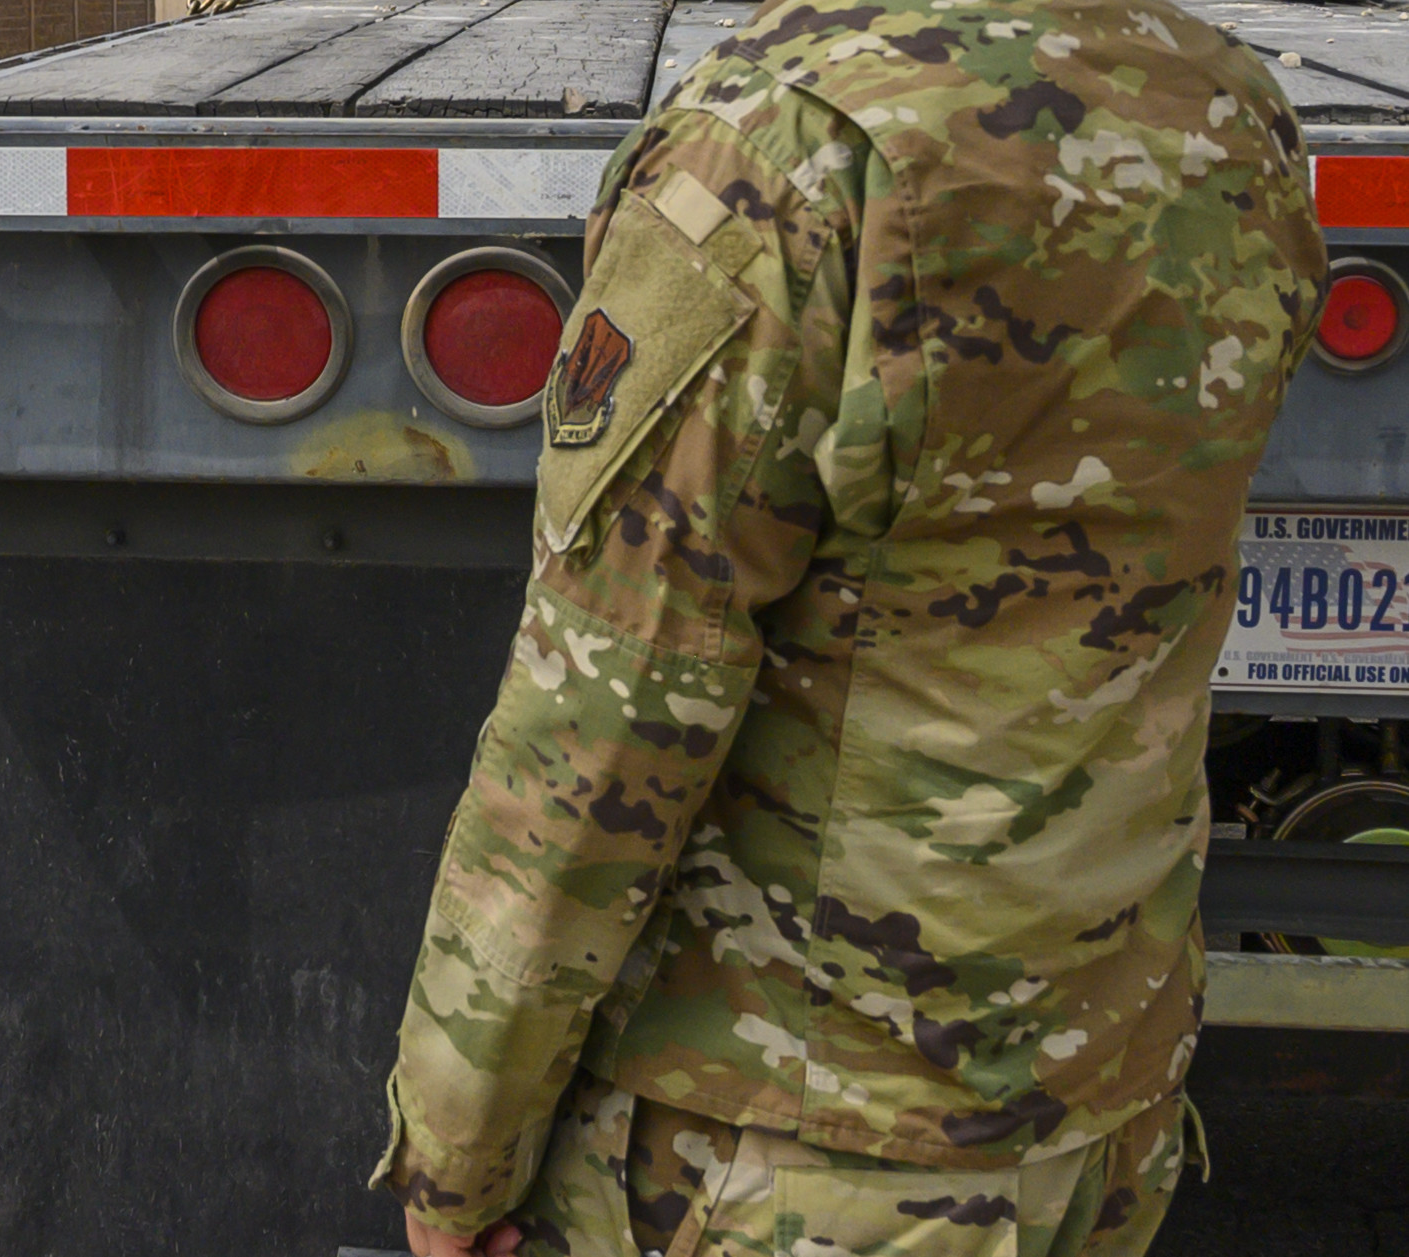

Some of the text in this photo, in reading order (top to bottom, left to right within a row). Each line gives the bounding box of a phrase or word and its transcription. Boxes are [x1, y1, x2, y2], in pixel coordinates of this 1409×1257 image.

[1254, 516, 1292, 539] U.S.
[1247, 662, 1279, 680] FOR
[1281, 663, 1351, 683] OFFICIAL
[1355, 665, 1385, 684] USE
